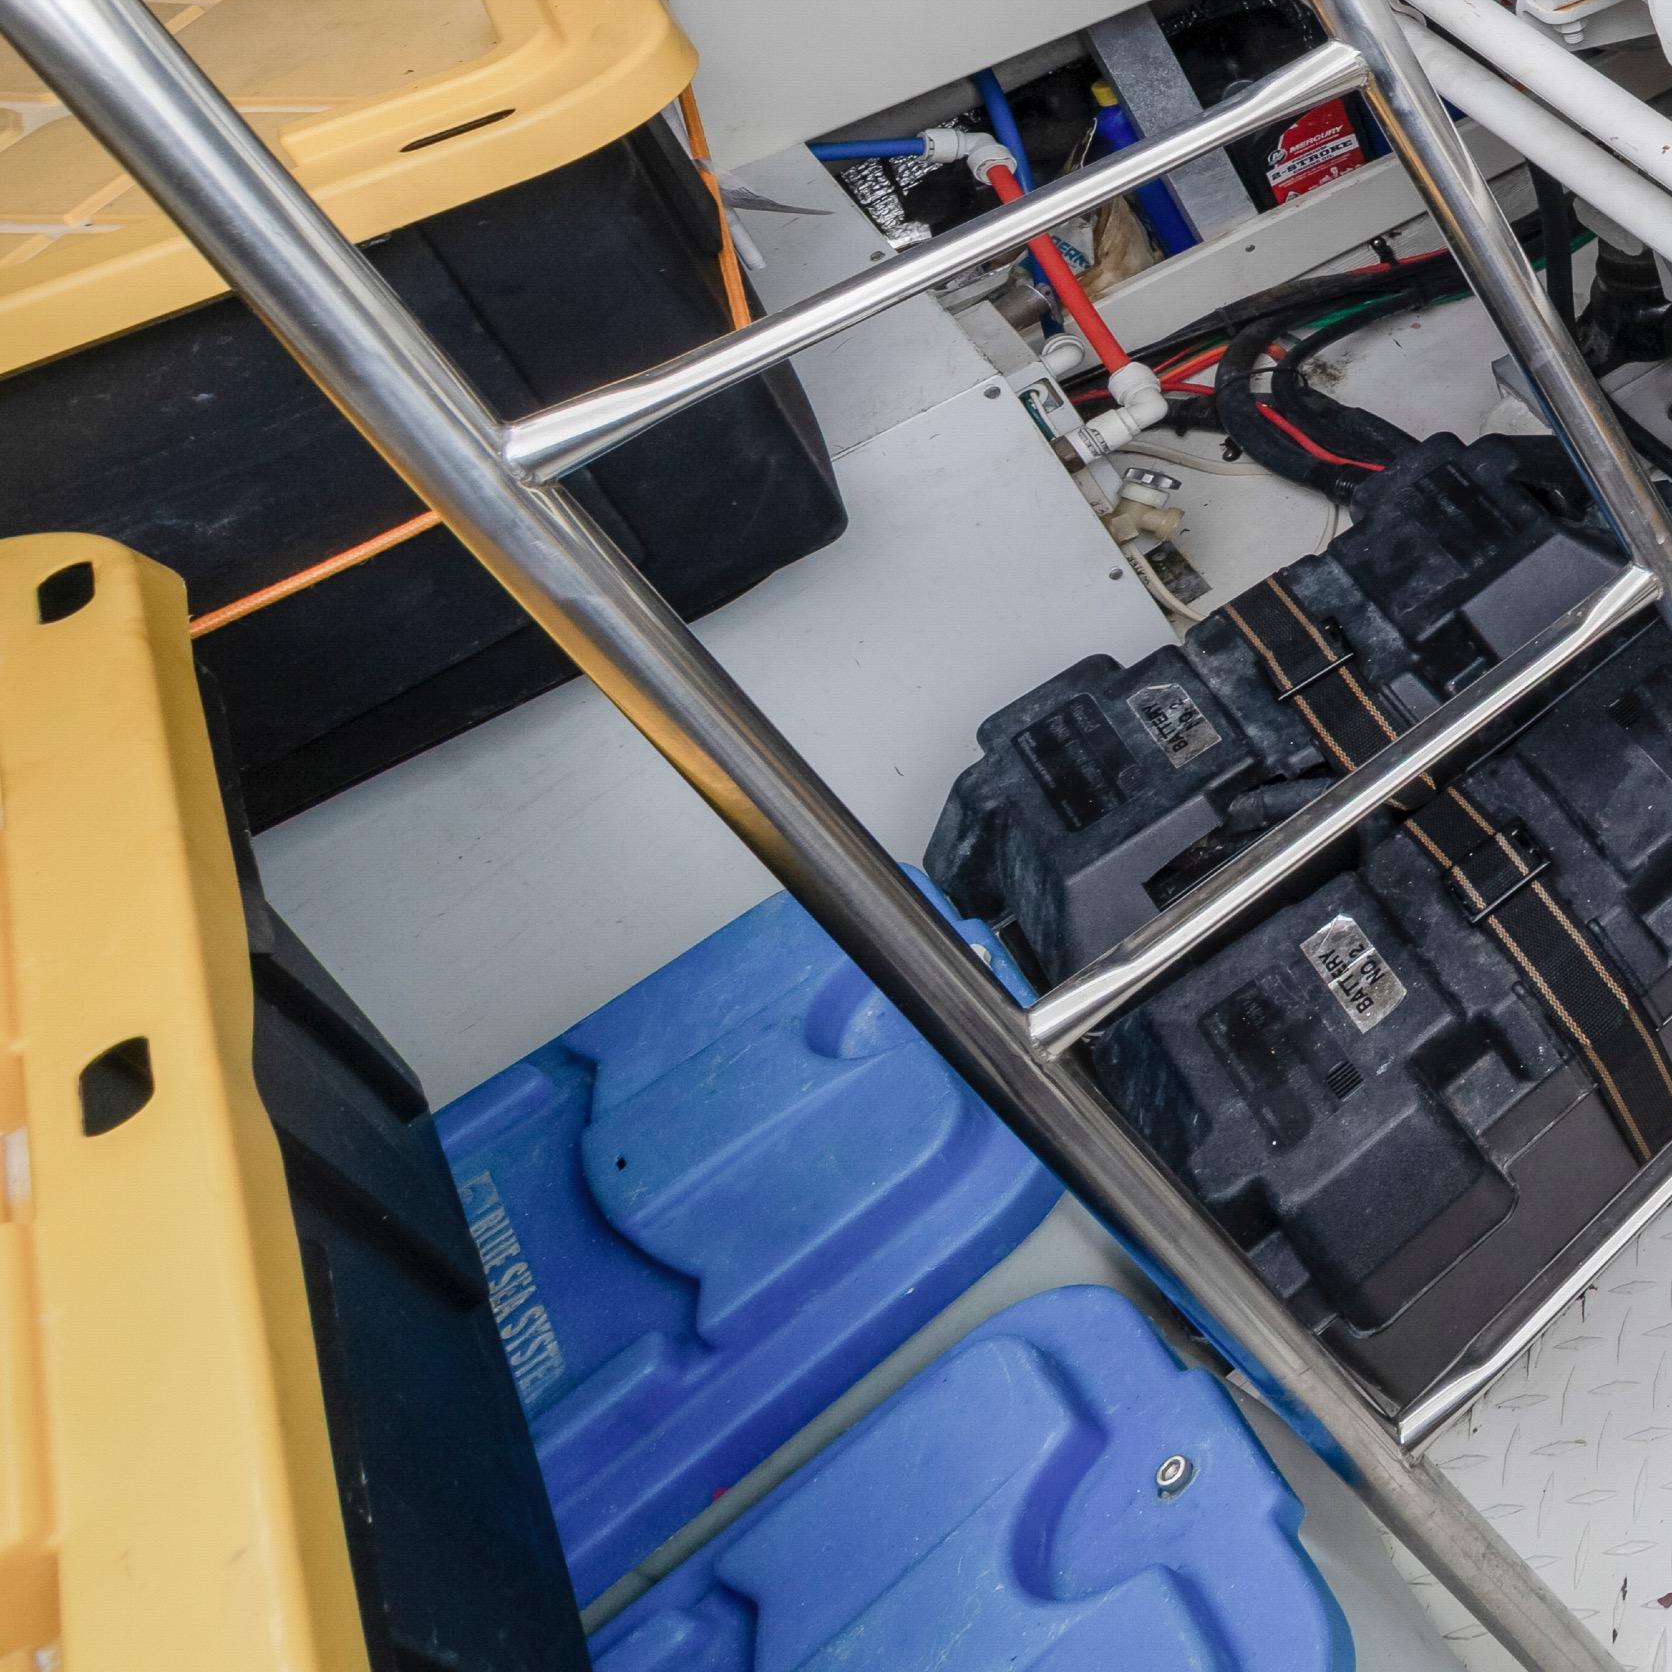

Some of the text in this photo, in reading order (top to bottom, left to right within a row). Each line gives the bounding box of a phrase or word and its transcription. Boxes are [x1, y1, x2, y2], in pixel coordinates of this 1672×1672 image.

[1271, 139, 1353, 181] 2-STROKE
[1290, 125, 1343, 153] MERCURY
[1142, 703, 1189, 753] BATTERY
[1348, 944, 1366, 959] 2
[1318, 949, 1374, 1014] BATTERY
[469, 1206, 521, 1274] BLUE
[488, 1261, 537, 1323] SEA
